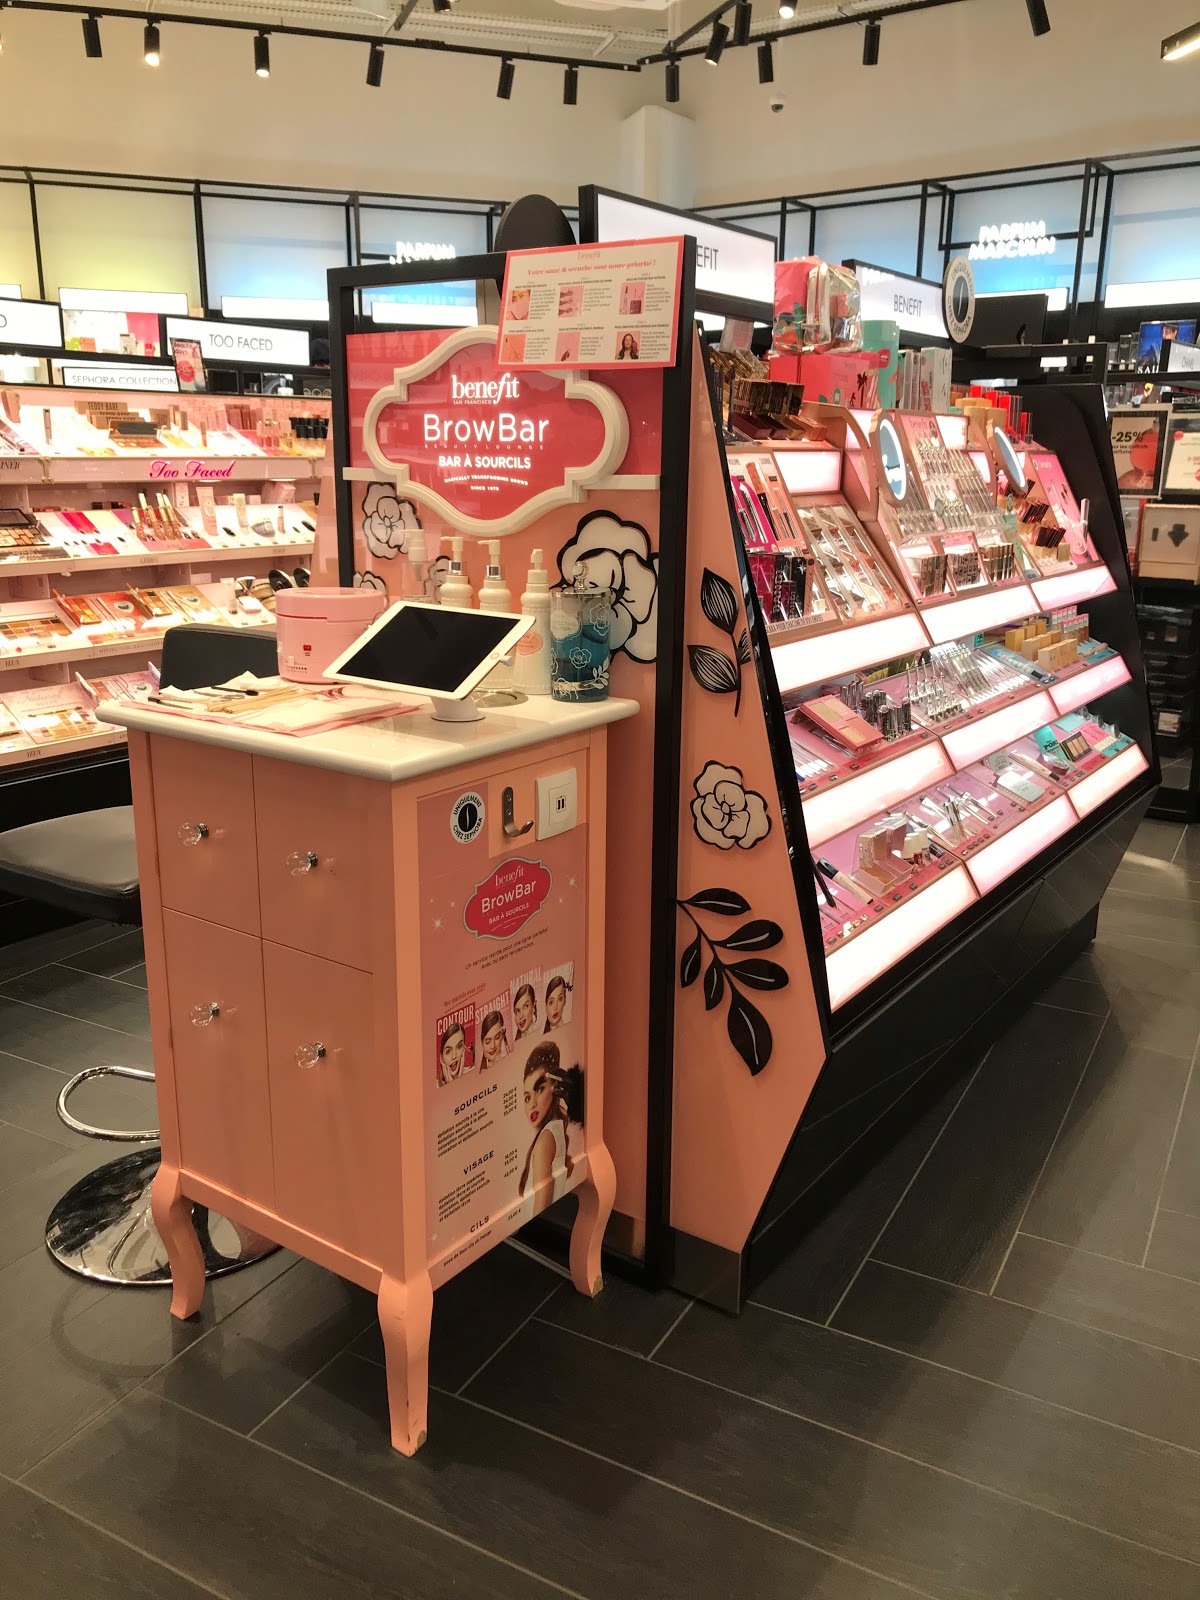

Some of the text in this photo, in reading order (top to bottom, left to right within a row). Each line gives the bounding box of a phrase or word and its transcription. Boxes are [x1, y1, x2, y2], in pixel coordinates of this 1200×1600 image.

[979, 221, 1046, 243] PARFUM
[968, 236, 1056, 260] MASCULIN
[894, 294, 922, 317] BENEFIT
[208, 333, 273, 351] TOO FACED
[72, 375, 177, 386] SEPHORA COLLECTION
[451, 372, 520, 405] benefit
[88, 402, 119, 411] TEDDY BARE
[423, 413, 550, 442] BrowBar
[1112, 431, 1144, 443] -25%
[149, 460, 236, 479] Too Faced
[438, 453, 532, 469] BAR À SOURCILS
[453, 795, 482, 816] UNIQUEMENT
[453, 817, 483, 840] CHEZ SEPHORA
[495, 865, 524, 887] benefit
[481, 880, 537, 913] BrowBar
[488, 915, 500, 925] BAR
[500, 911, 505, 919] À
[505, 902, 530, 918] SOURCILS
[472, 956, 488, 967] service
[488, 948, 502, 960] rapide
[502, 944, 513, 953] pour
[513, 940, 522, 948] une
[481, 961, 492, 970] Avec
[498, 954, 509, 962] sans
[510, 966, 543, 995] NATURAL
[475, 991, 510, 1025] STRAIGHT
[437, 1004, 474, 1036] CONTOUR
[454, 1083, 498, 1116] SOURCILS
[463, 1150, 495, 1175] VISAGE
[470, 1215, 490, 1233] CILS
